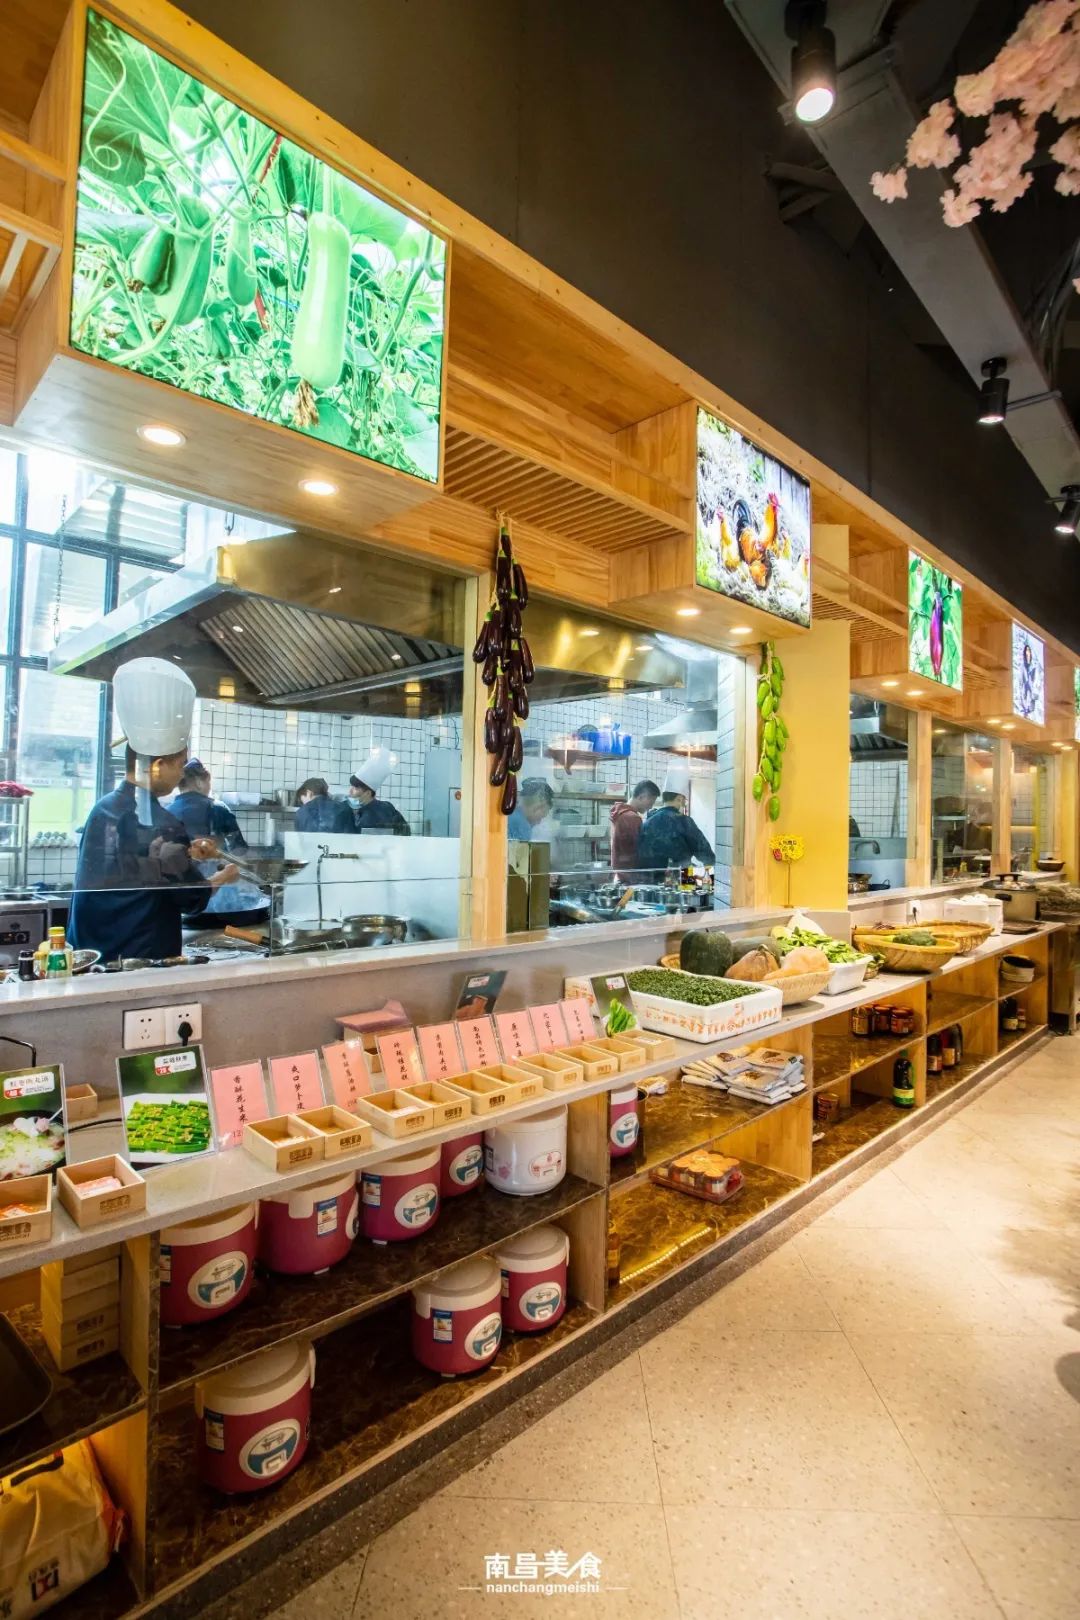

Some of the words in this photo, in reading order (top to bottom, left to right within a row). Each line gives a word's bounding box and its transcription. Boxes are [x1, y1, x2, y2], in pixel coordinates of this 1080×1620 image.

[233, 1075, 248, 1123] 香酥花生米
